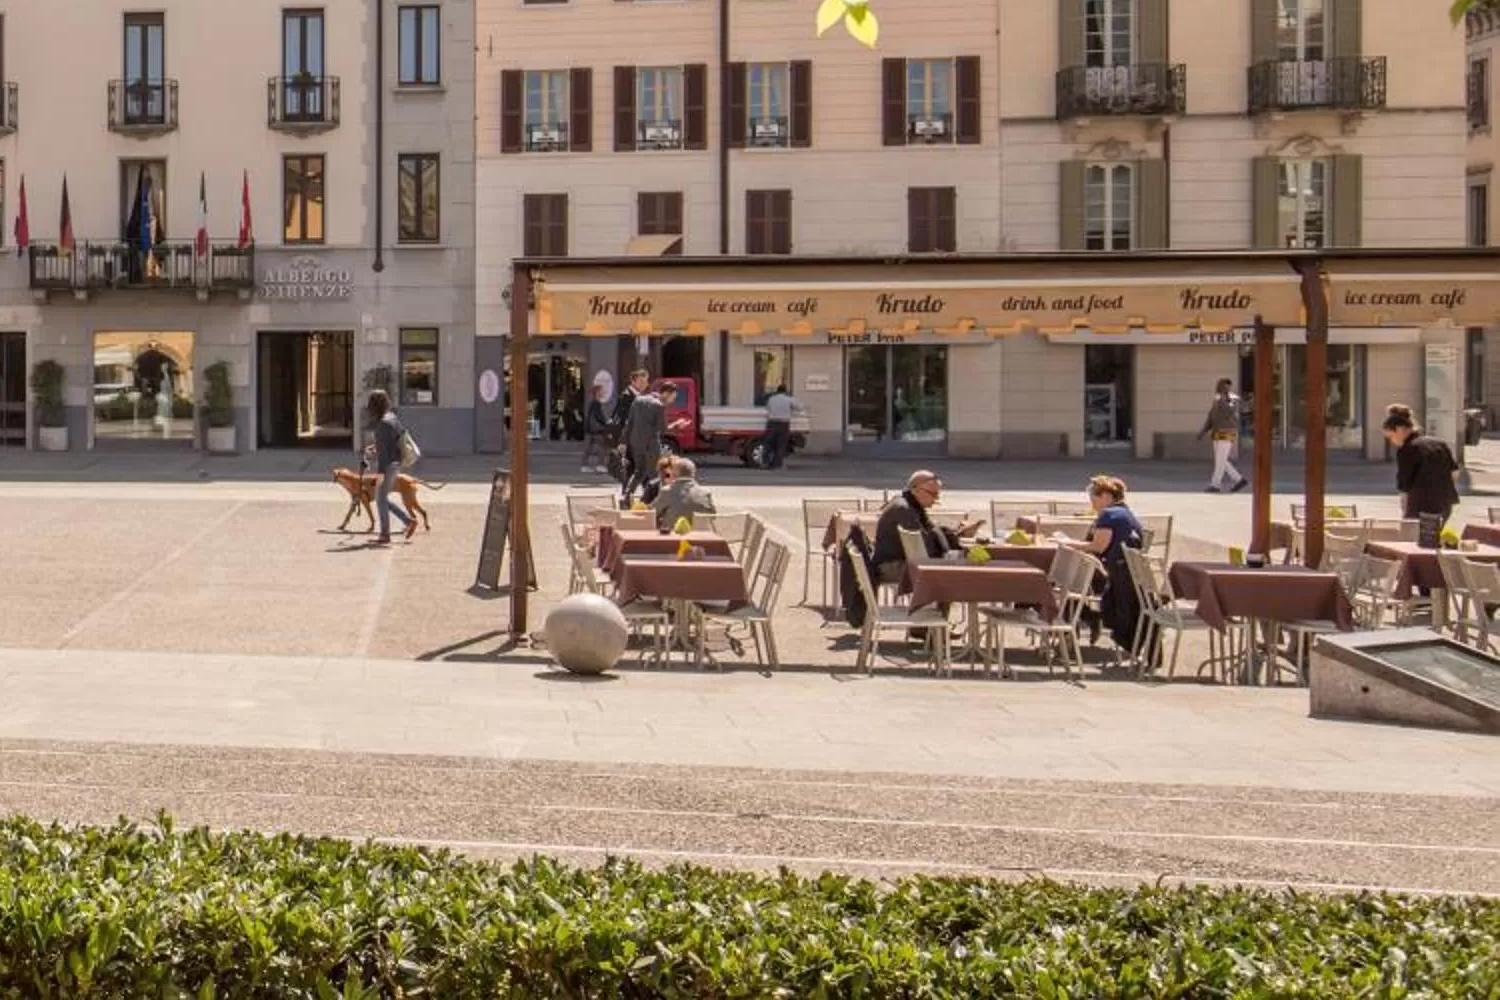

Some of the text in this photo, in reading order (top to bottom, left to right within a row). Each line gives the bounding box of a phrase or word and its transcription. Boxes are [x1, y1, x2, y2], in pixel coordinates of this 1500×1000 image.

[263, 268, 350, 283] ALBERGO
[263, 284, 350, 297] FIRENZE
[1180, 288, 1252, 310] Krudo
[1344, 288, 1466, 309] ice cream café
[588, 295, 653, 316] Krudo
[707, 297, 819, 317] ice cream café
[875, 293, 945, 314] Krudo
[1001, 295, 1124, 314] drink and food
